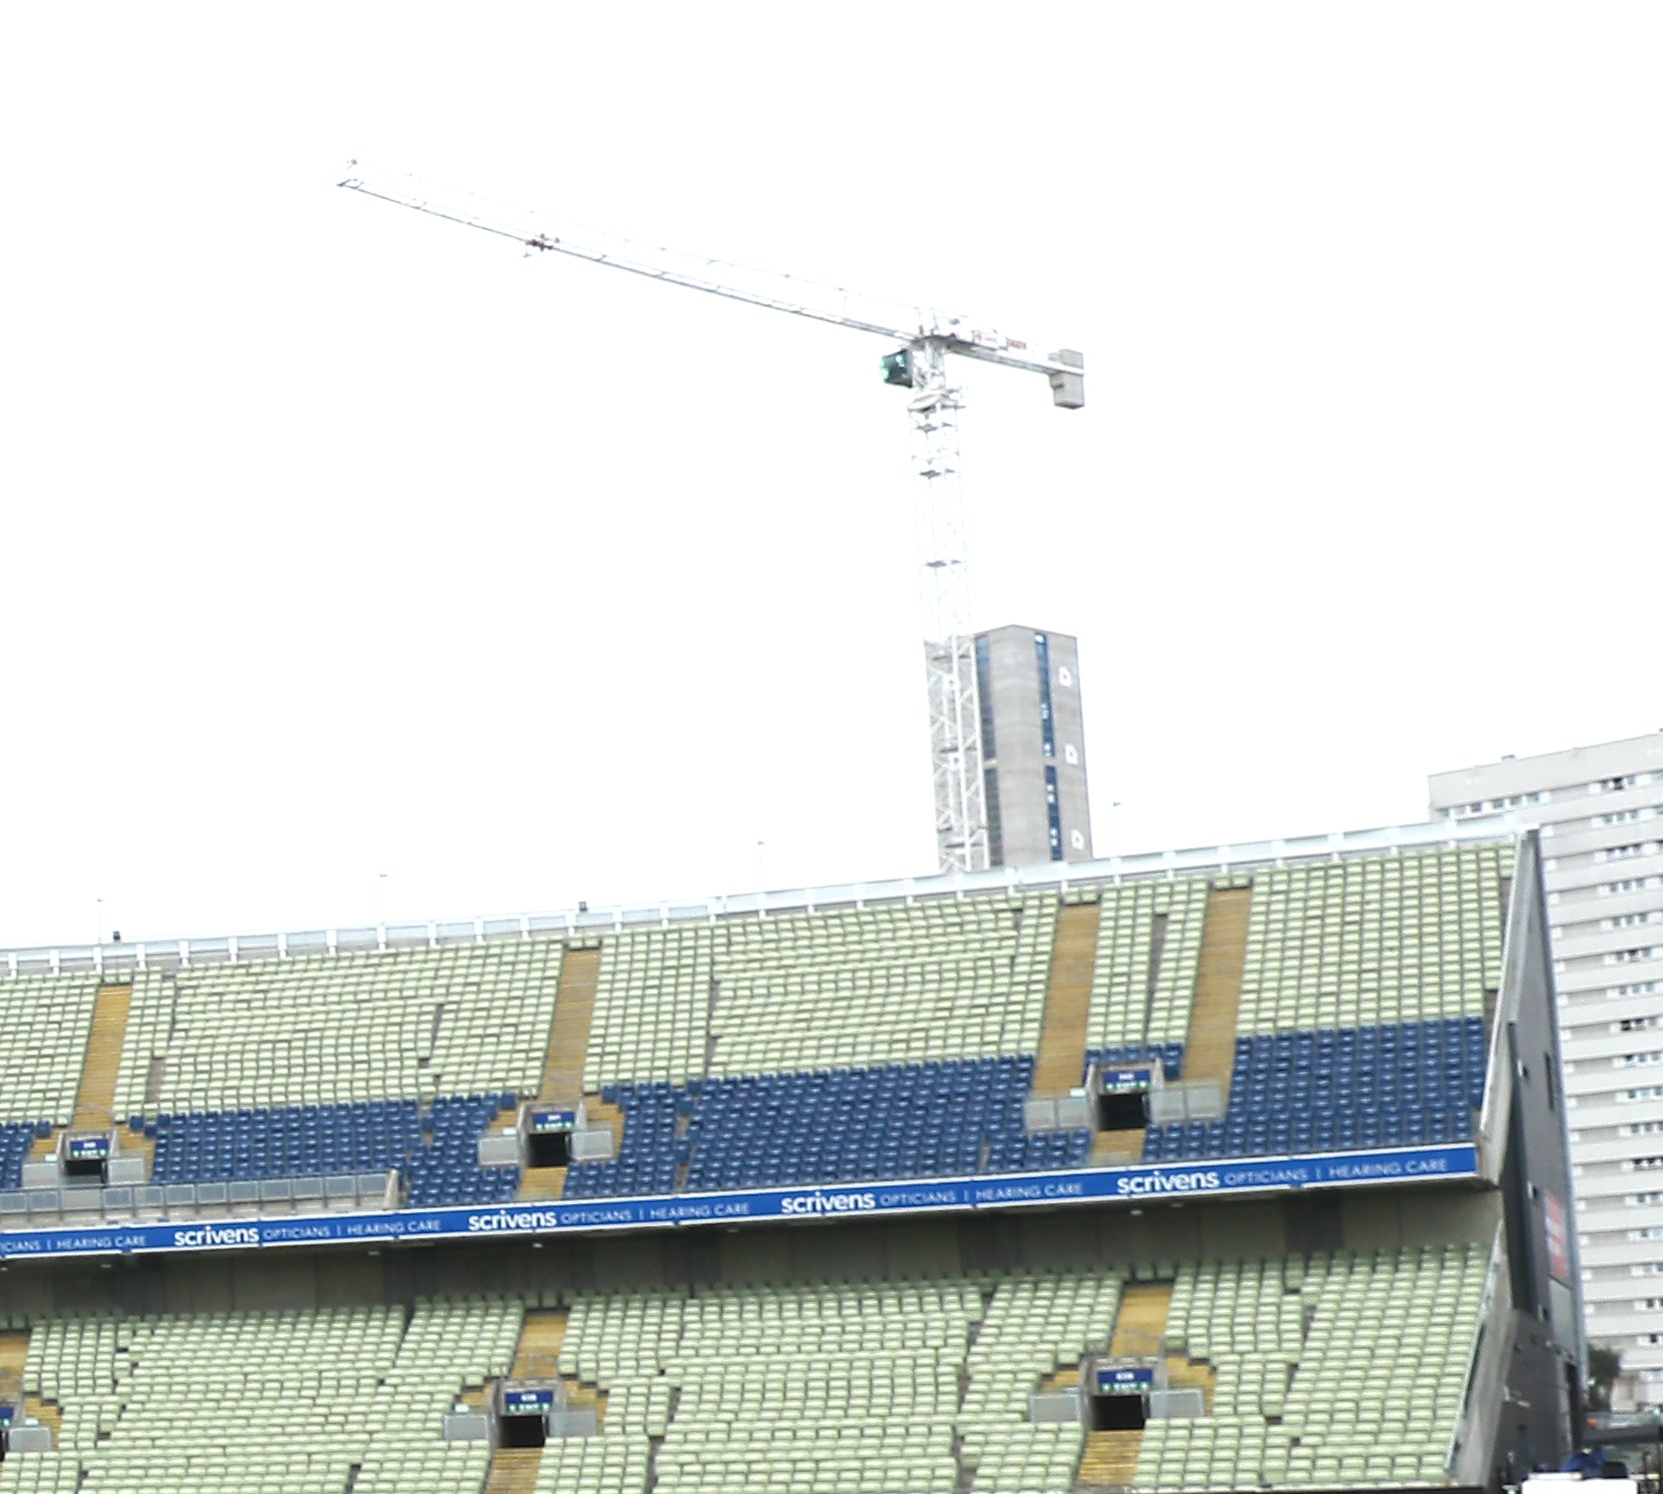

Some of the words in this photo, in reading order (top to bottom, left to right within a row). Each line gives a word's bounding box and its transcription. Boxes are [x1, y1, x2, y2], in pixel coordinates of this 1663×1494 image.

[1117, 1170, 1220, 1195] scrivens
[1225, 1167, 1309, 1186] OPTICIANS
[1329, 1162, 1401, 1179] HEARING
[1405, 1158, 1448, 1173] CARE
[781, 1191, 875, 1214] scrivens
[880, 1190, 955, 1206] OPTICIANS
[976, 1185, 1041, 1201] HEARING
[1044, 1183, 1083, 1197] CARE
[468, 1209, 557, 1231] scrivens
[561, 1209, 632, 1224] OPTICIANS
[650, 1205, 711, 1219] HEARING
[713, 1202, 750, 1215] CARE
[57, 1238, 112, 1249] HEARING
[115, 1235, 146, 1247] CARE
[174, 1225, 260, 1246] scrivens
[263, 1227, 330, 1240] OPTICIANS
[347, 1222, 405, 1236] HEARING
[407, 1220, 441, 1232] CARE
